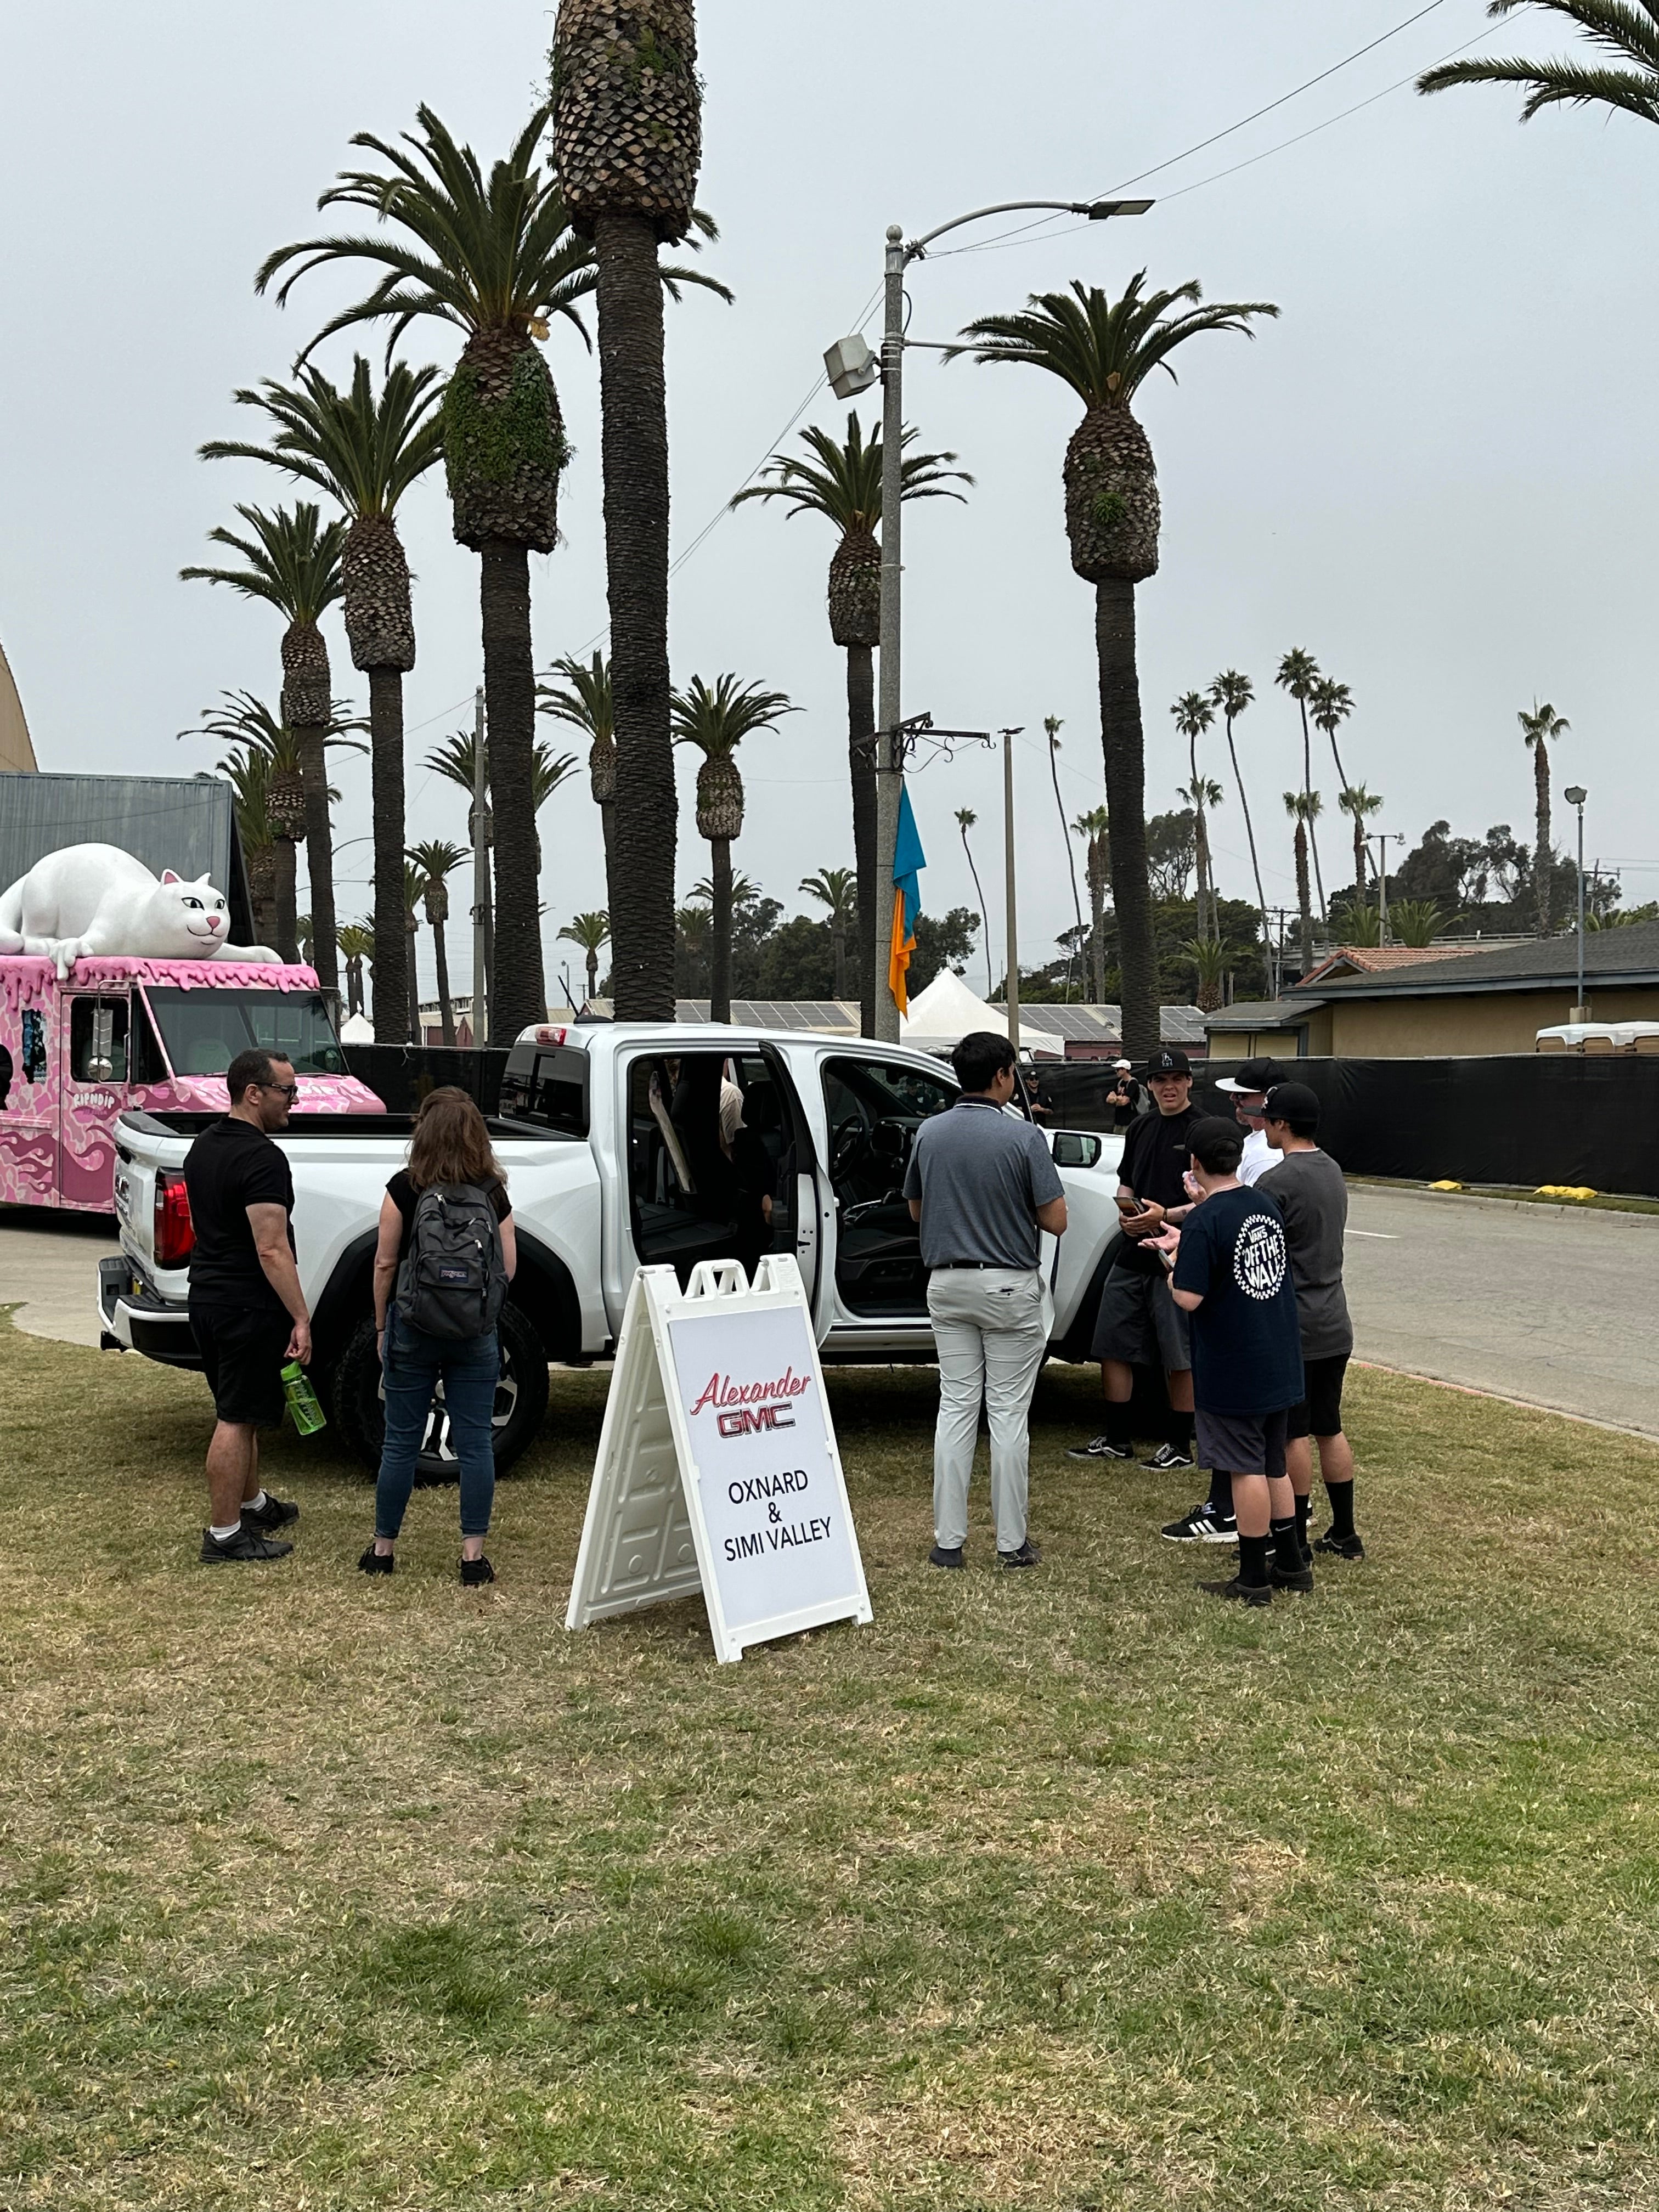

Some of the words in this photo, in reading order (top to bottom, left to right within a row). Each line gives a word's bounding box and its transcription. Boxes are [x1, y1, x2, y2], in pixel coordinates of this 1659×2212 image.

[1248, 1225, 1267, 1243] VANS
[1259, 1234, 1279, 1261] THE
[690, 1366, 811, 1415] Alexander
[716, 1401, 795, 1438] GMC
[729, 1470, 808, 1504] OXNARD
[768, 1502, 782, 1523] &
[724, 1532, 764, 1561] SIMI
[766, 1516, 831, 1550] VALLEY
